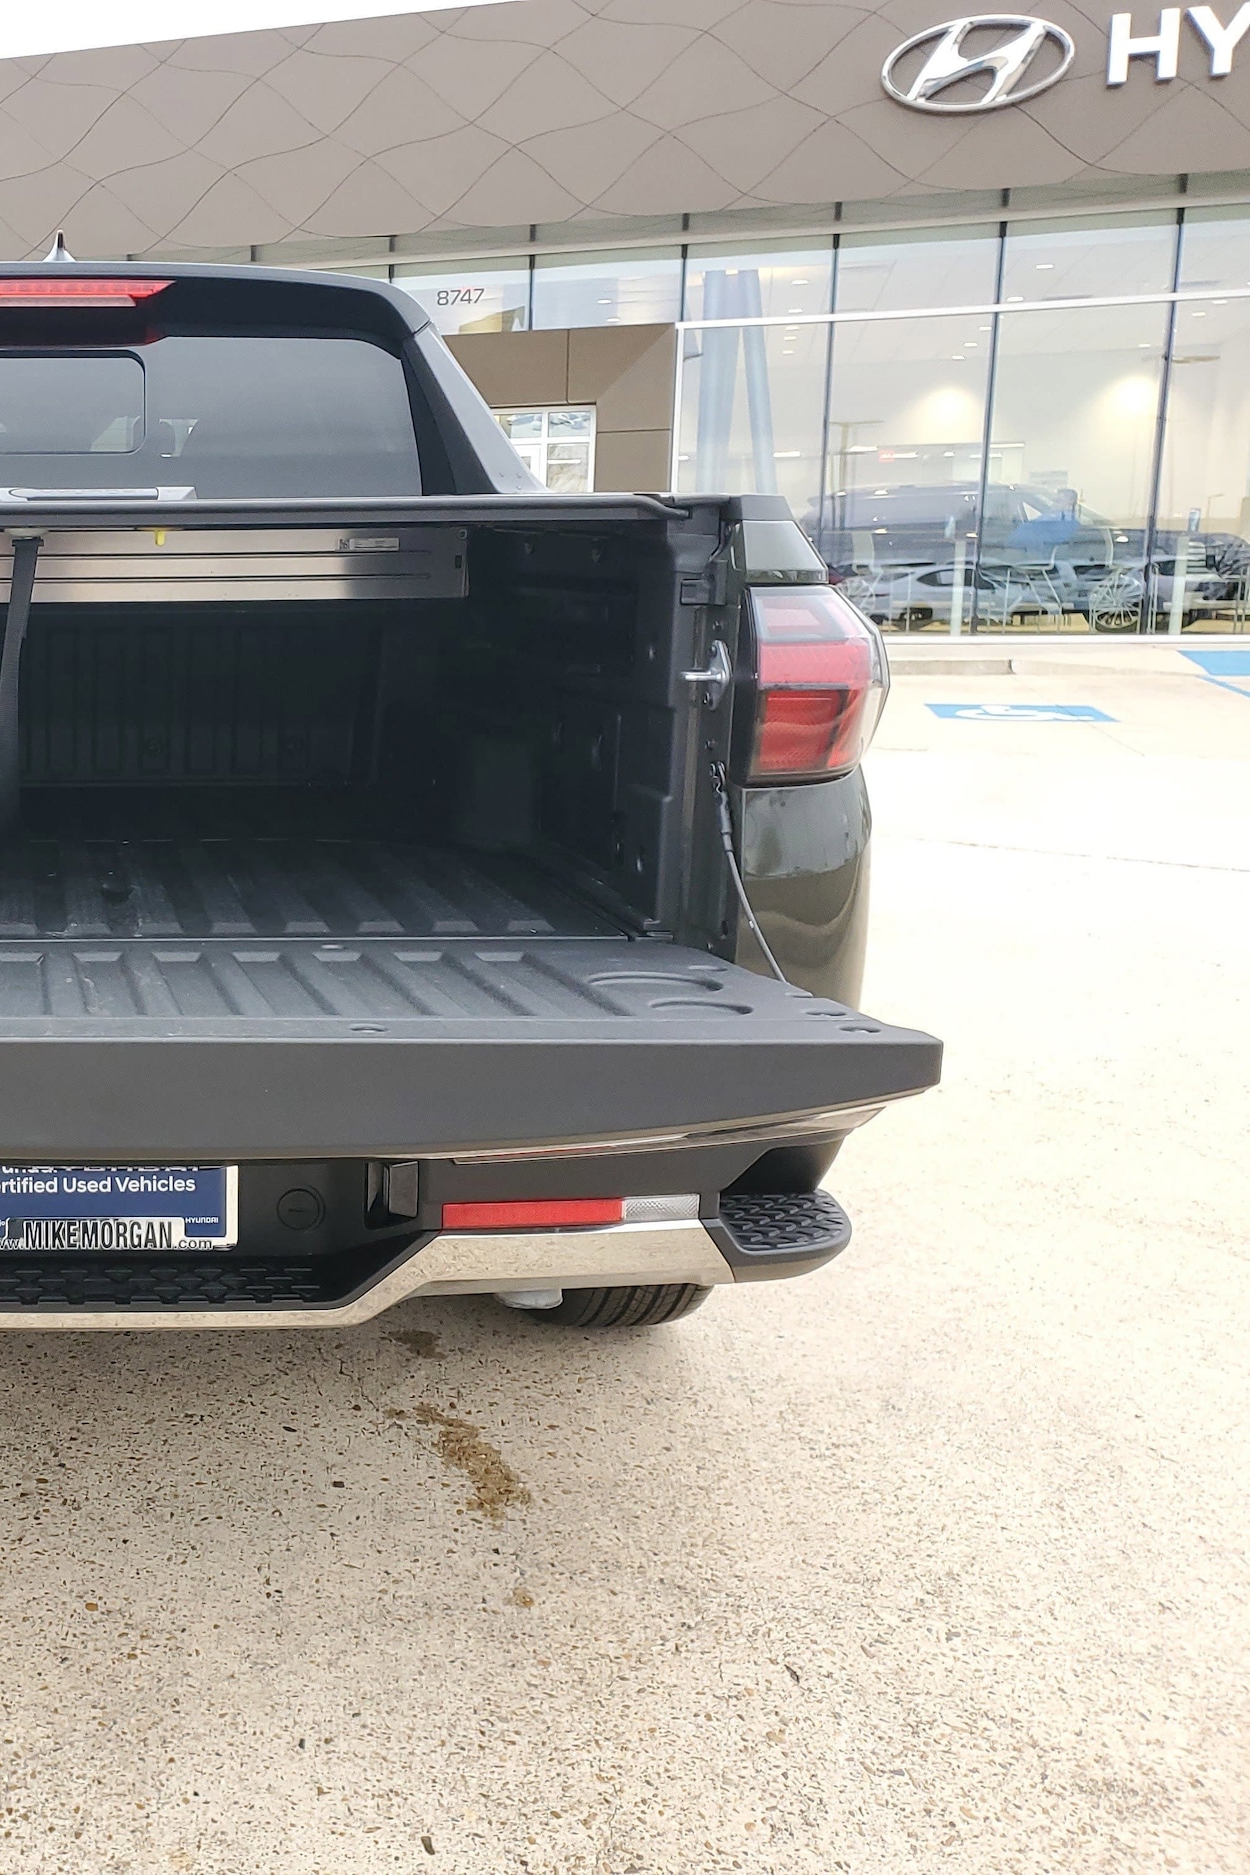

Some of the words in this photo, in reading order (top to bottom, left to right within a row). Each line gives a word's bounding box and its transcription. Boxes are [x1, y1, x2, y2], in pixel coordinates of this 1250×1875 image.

[1106, 2, 1250, 86] HY
[437, 288, 485, 306] 8747
[63, 1177, 111, 1193] Used
[115, 1175, 196, 1192] Vehicles
[185, 1216, 219, 1224] HYUNDAI
